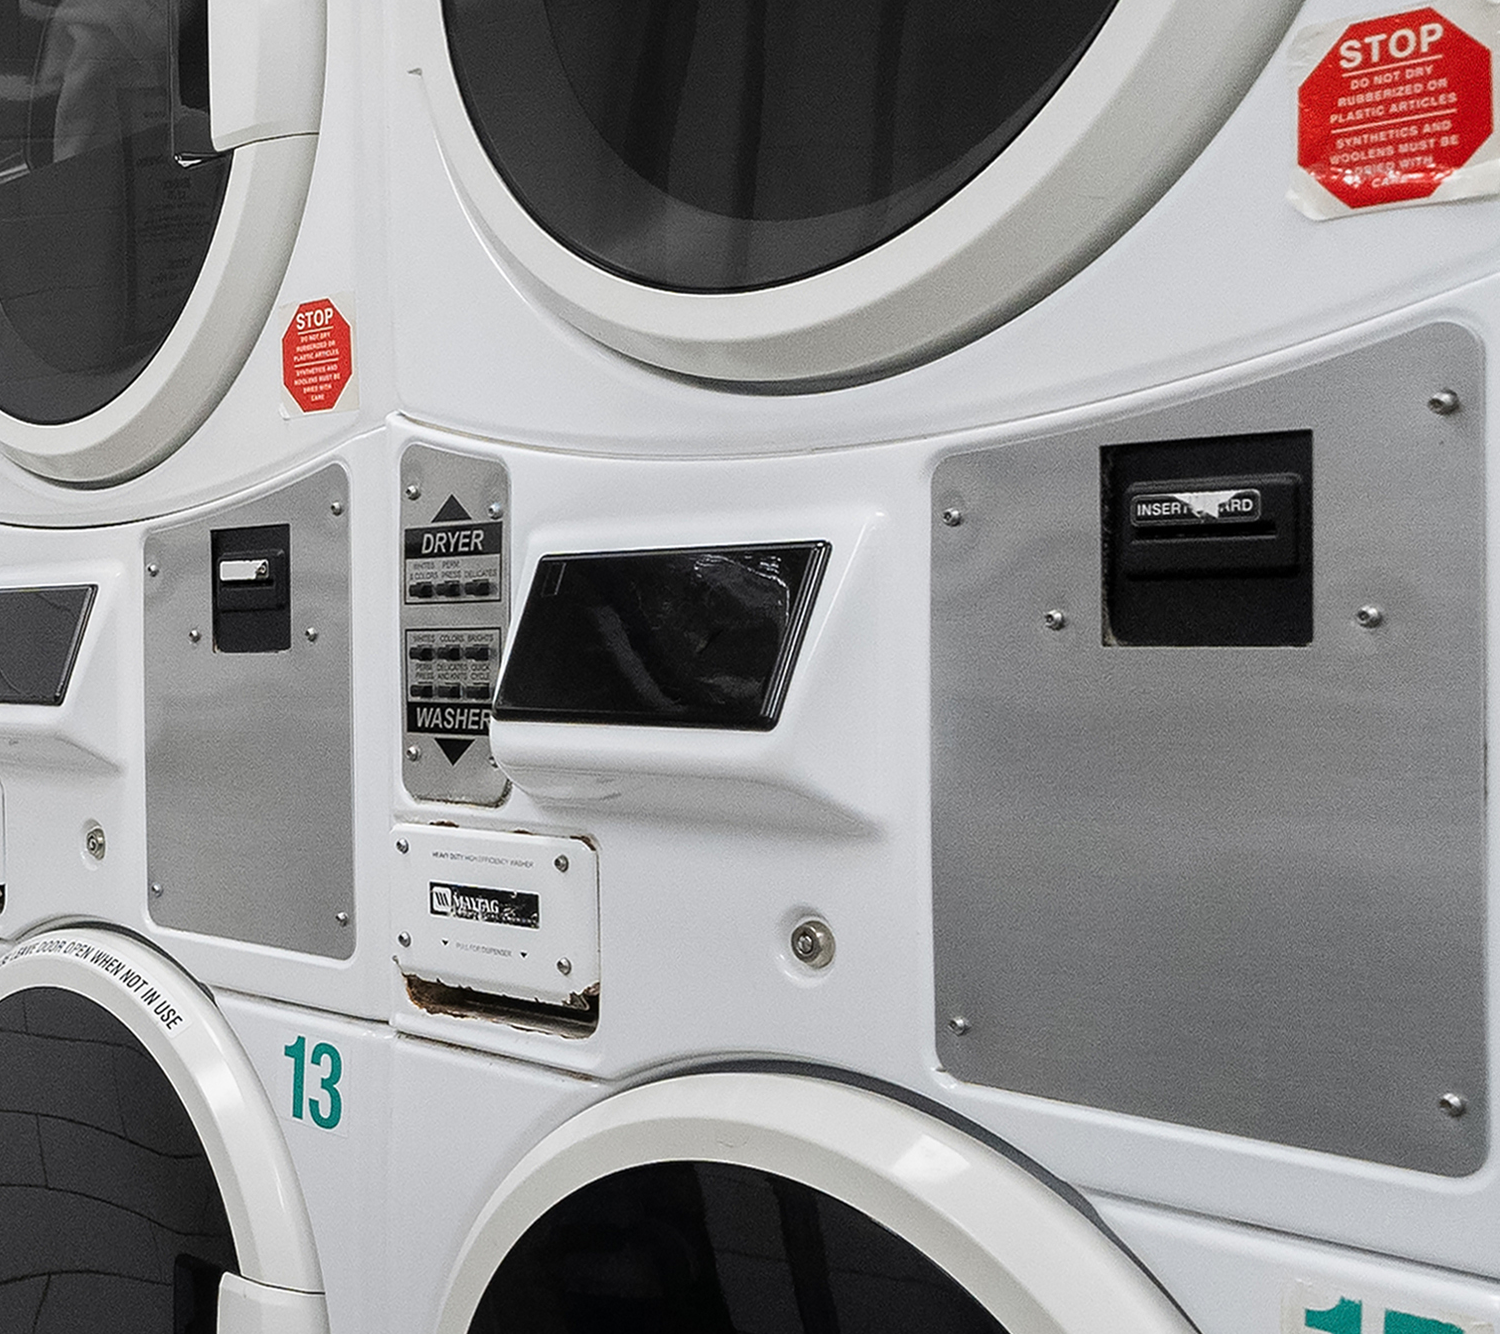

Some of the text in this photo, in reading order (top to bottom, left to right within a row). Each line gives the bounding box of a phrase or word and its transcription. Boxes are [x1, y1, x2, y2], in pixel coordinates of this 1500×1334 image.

[1339, 23, 1444, 69] STOP
[1351, 65, 1434, 90] DO NOT DRY
[1337, 78, 1448, 107] RUBBERIZED OR
[1329, 92, 1457, 124] PLASTIC ARTICLES
[1336, 120, 1452, 149] SYNTHETICS AND
[1329, 134, 1460, 165] WOOLENS MUST BE
[1400, 154, 1433, 168] WITH
[296, 308, 334, 330] STOP
[1219, 499, 1253, 512] ARD
[421, 530, 484, 554] DRYER
[416, 707, 491, 730] WASHER
[35, 940, 183, 1031] DOOR OPEN WHEN NOT IN USE
[283, 1035, 342, 1130] 13
